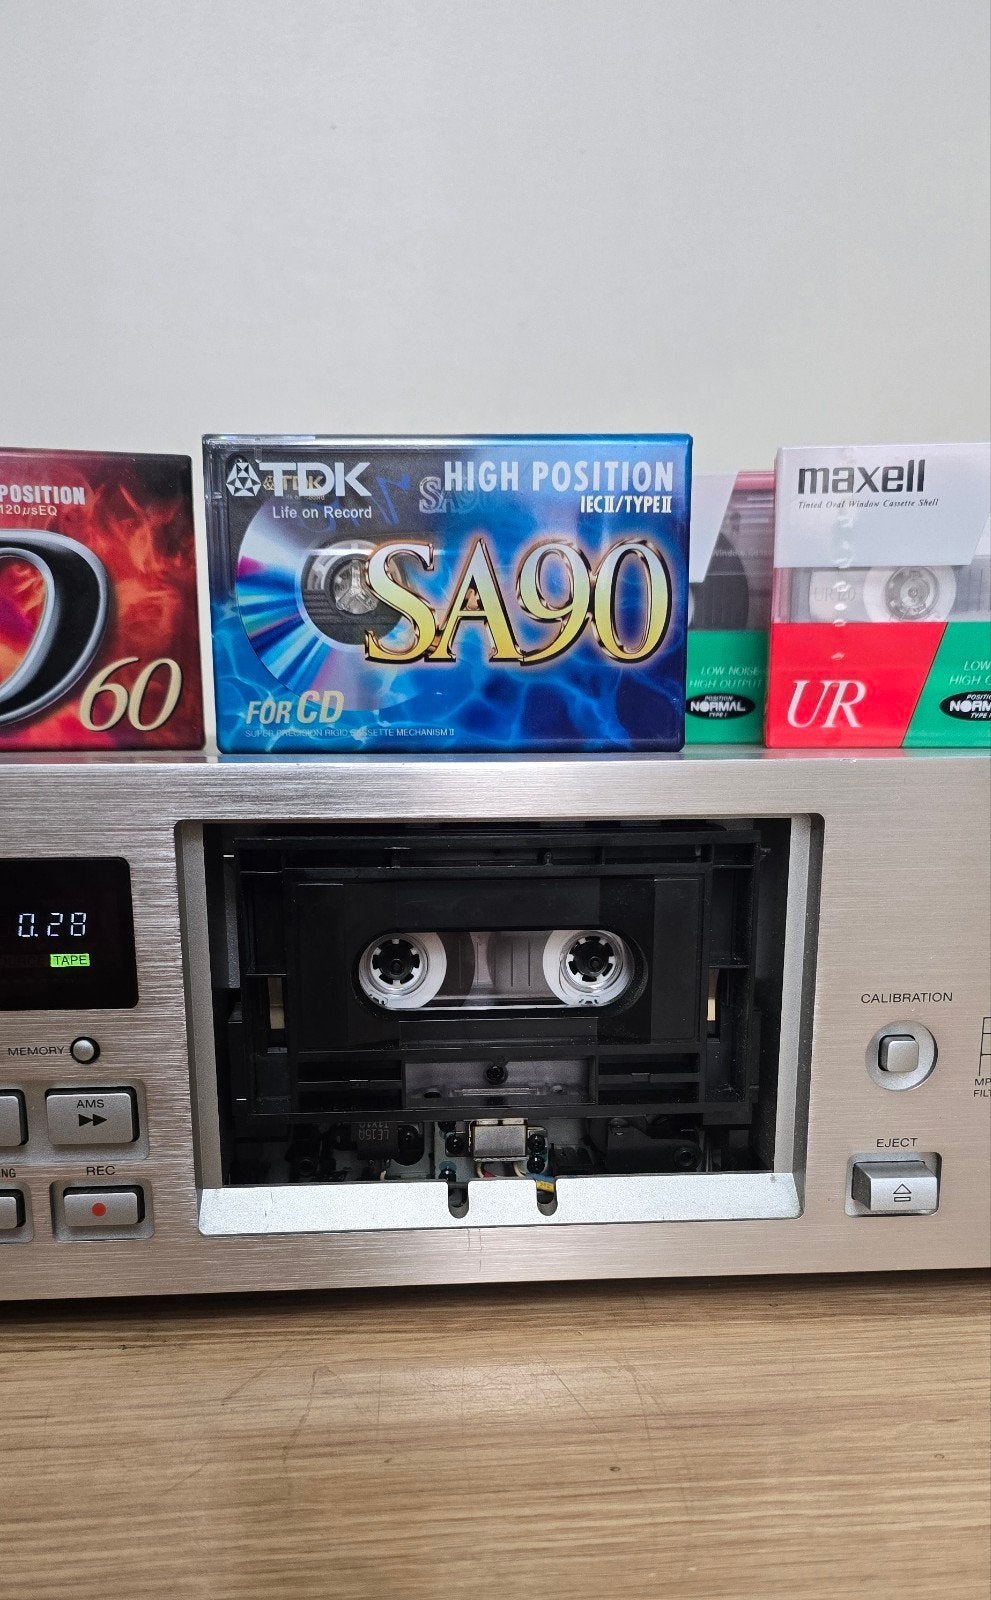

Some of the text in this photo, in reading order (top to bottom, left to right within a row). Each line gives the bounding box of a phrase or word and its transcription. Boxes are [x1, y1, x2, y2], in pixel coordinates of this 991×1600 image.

[259, 462, 372, 496] TDK
[445, 460, 674, 492] HIGH POSITION
[798, 459, 925, 494] maxell
[0, 484, 86, 506] POSITION
[798, 501, 822, 509] Tinted
[848, 500, 880, 508] Window
[883, 499, 915, 507] Cassette
[919, 498, 939, 506] Shell
[272, 506, 373, 519] Life on Record
[365, 537, 673, 666] SA90
[700, 666, 725, 676] LOW
[963, 660, 991, 671] LOW
[689, 679, 717, 689] HIGH
[948, 675, 981, 685] HIGH
[79, 657, 182, 732] 60
[245, 690, 345, 725] FOR CD
[690, 700, 746, 712] NORMAL
[787, 679, 866, 728] UR
[245, 729, 274, 738] SUPER
[276, 729, 323, 737] PRECISION
[396, 728, 448, 737] MECHANISM
[18, 912, 87, 938] 0.28
[52, 954, 88, 966] TAPE
[860, 992, 953, 1004] CALIBRATION
[7, 1046, 65, 1056] MEMORY
[76, 1099, 105, 1109] AMS
[876, 1137, 918, 1148] EJECT
[1, 1168, 17, 1178] NG
[86, 1166, 116, 1176] REC
